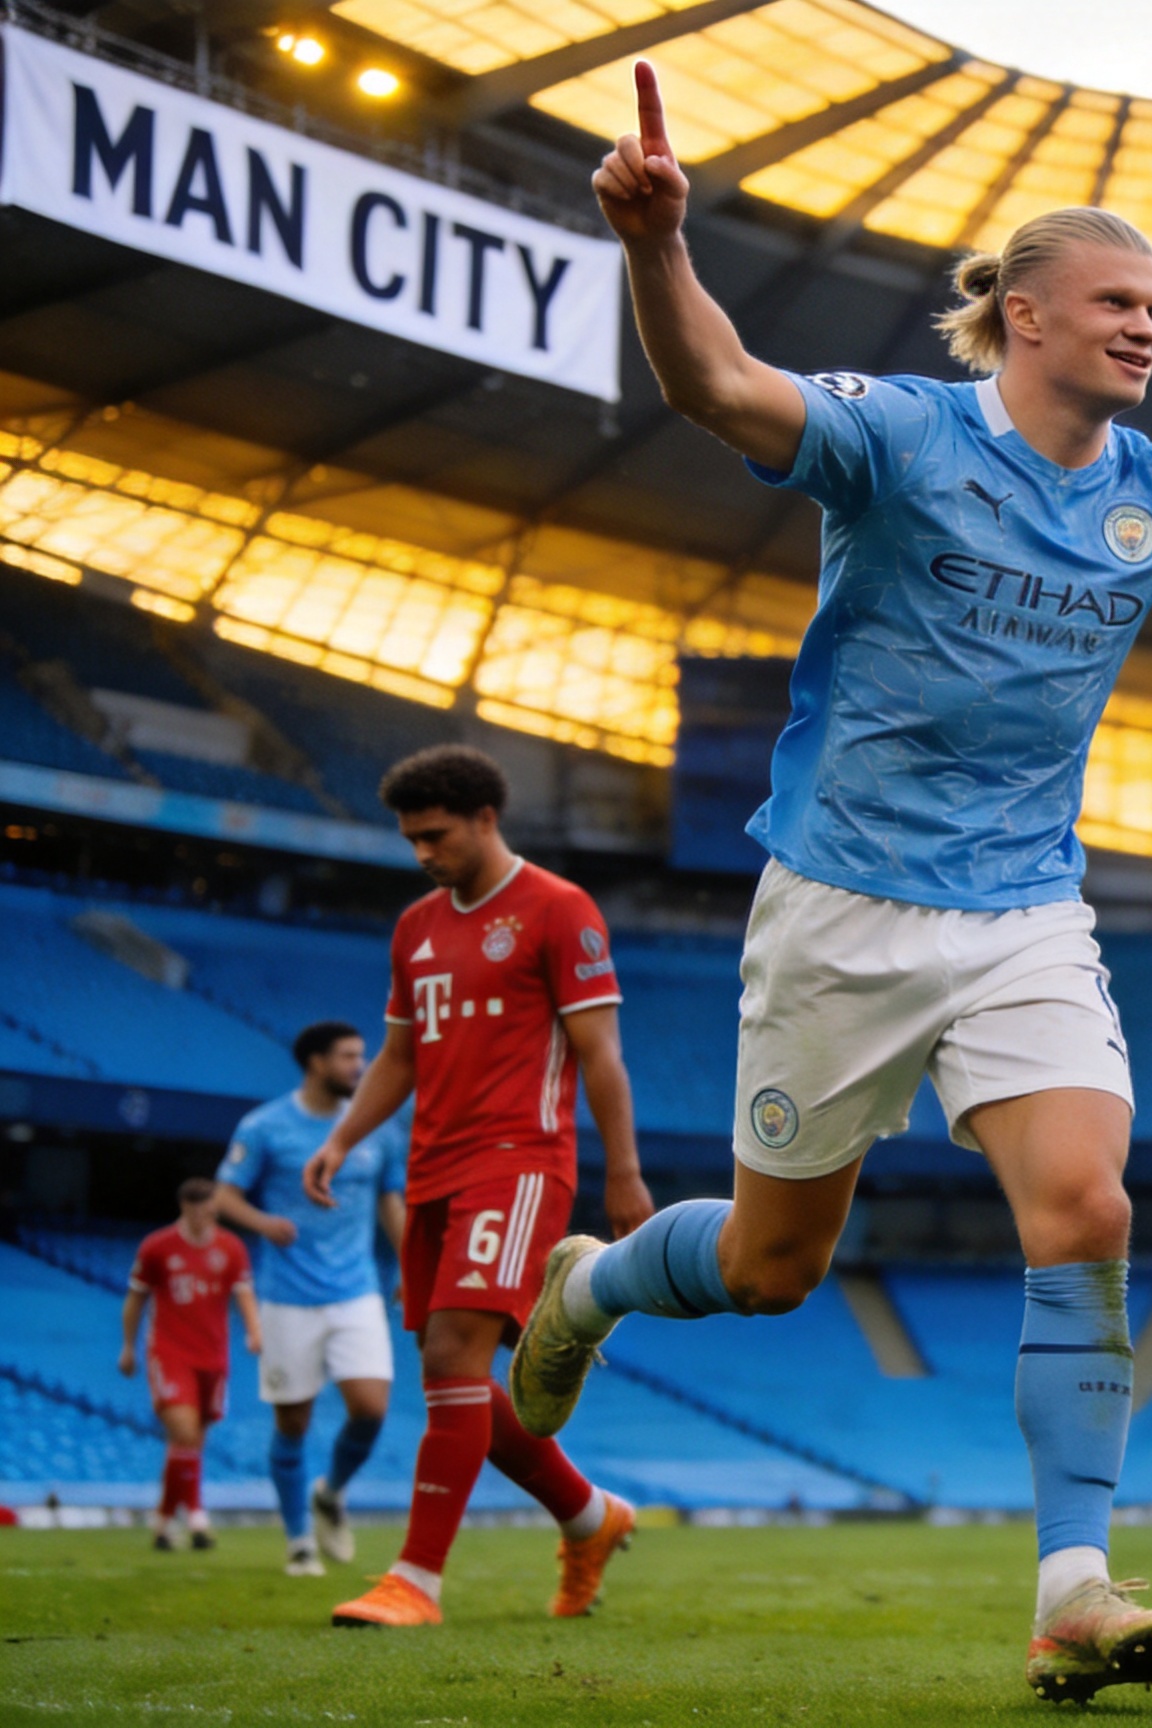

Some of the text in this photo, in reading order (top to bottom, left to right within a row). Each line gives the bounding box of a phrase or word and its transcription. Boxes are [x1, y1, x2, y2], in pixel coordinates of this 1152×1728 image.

[71, 80, 572, 353] MAN CITY
[929, 552, 1144, 627] ETIHAD
[468, 1209, 505, 1265] 6
